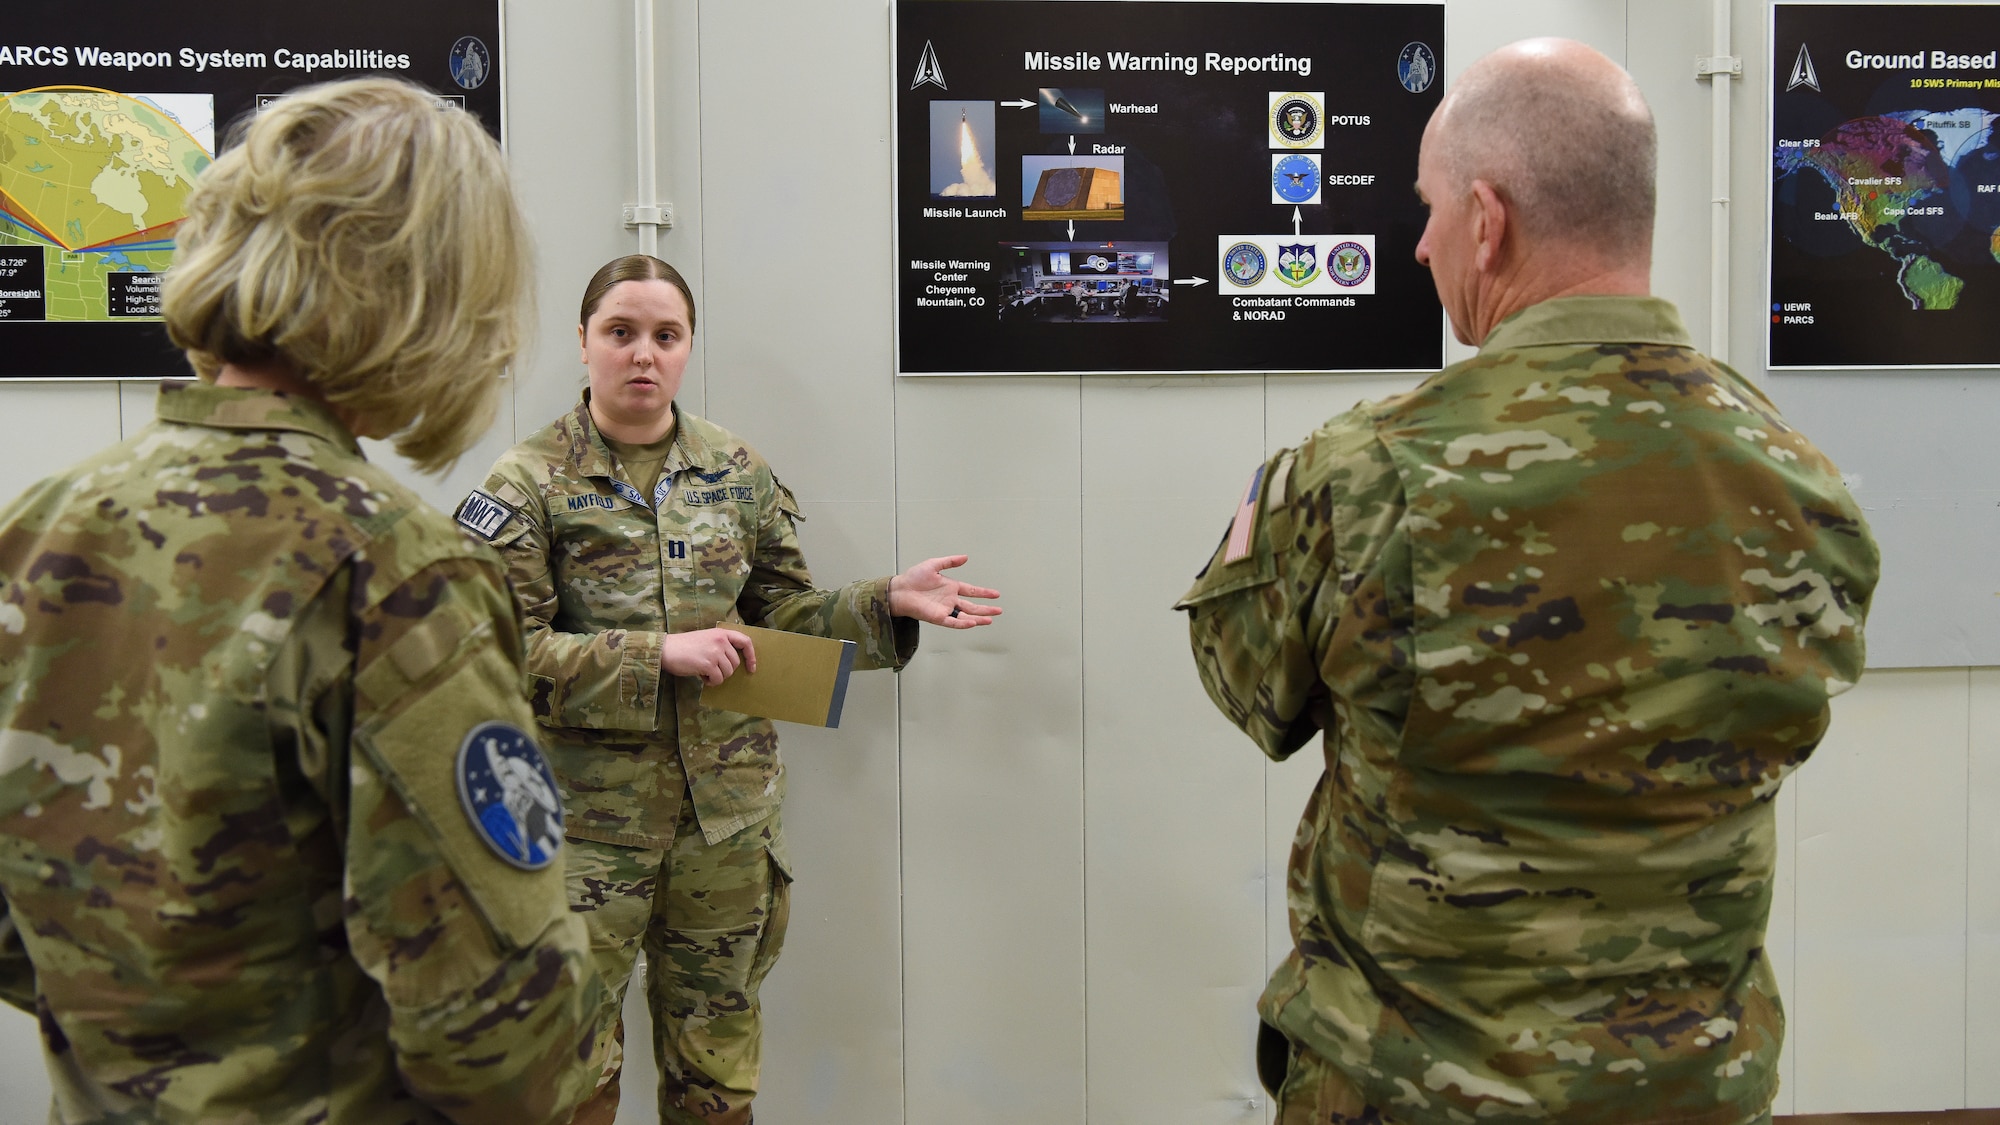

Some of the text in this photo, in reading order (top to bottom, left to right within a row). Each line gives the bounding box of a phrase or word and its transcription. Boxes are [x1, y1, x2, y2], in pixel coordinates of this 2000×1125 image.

[75, 47, 171, 71] Weapon
[179, 48, 266, 72] System
[274, 49, 410, 72] Capabilities
[1025, 52, 1311, 76] Missile Warning Reporting
[1846, 51, 1996, 69] Ground Based
[1910, 79, 1923, 88] 10
[1924, 79, 1944, 88] SWS
[1946, 79, 1982, 90] Primary
[1110, 104, 1158, 113] Warhead
[1332, 116, 1370, 125] POTUS
[1926, 120, 1971, 128] Pituffik SB
[1778, 139, 1821, 148] Clear SFS
[1092, 144, 1126, 154] Radar
[1329, 175, 1375, 185] SECDEF
[1848, 177, 1902, 186] Cavalier SFS
[1977, 184, 1996, 193] RAF
[924, 208, 1006, 217] Missile Launch
[1814, 212, 1858, 221] Beale AFB
[1883, 207, 1944, 217] Cape Cod SFS
[912, 260, 990, 271] Missile Warning
[934, 273, 968, 281] Center
[125, 285, 162, 294] Volumetri
[926, 285, 976, 296] Cheyenne
[917, 297, 985, 307] Mountain, CO
[1233, 297, 1355, 307] Combatant Commands
[126, 306, 148, 314] Local
[1784, 303, 1811, 312] UEWR
[1233, 311, 1285, 320] & NORAD
[1784, 316, 1814, 324] PARCS
[686, 486, 754, 504] U.S. SPACE FORCE
[462, 496, 504, 530] MWT
